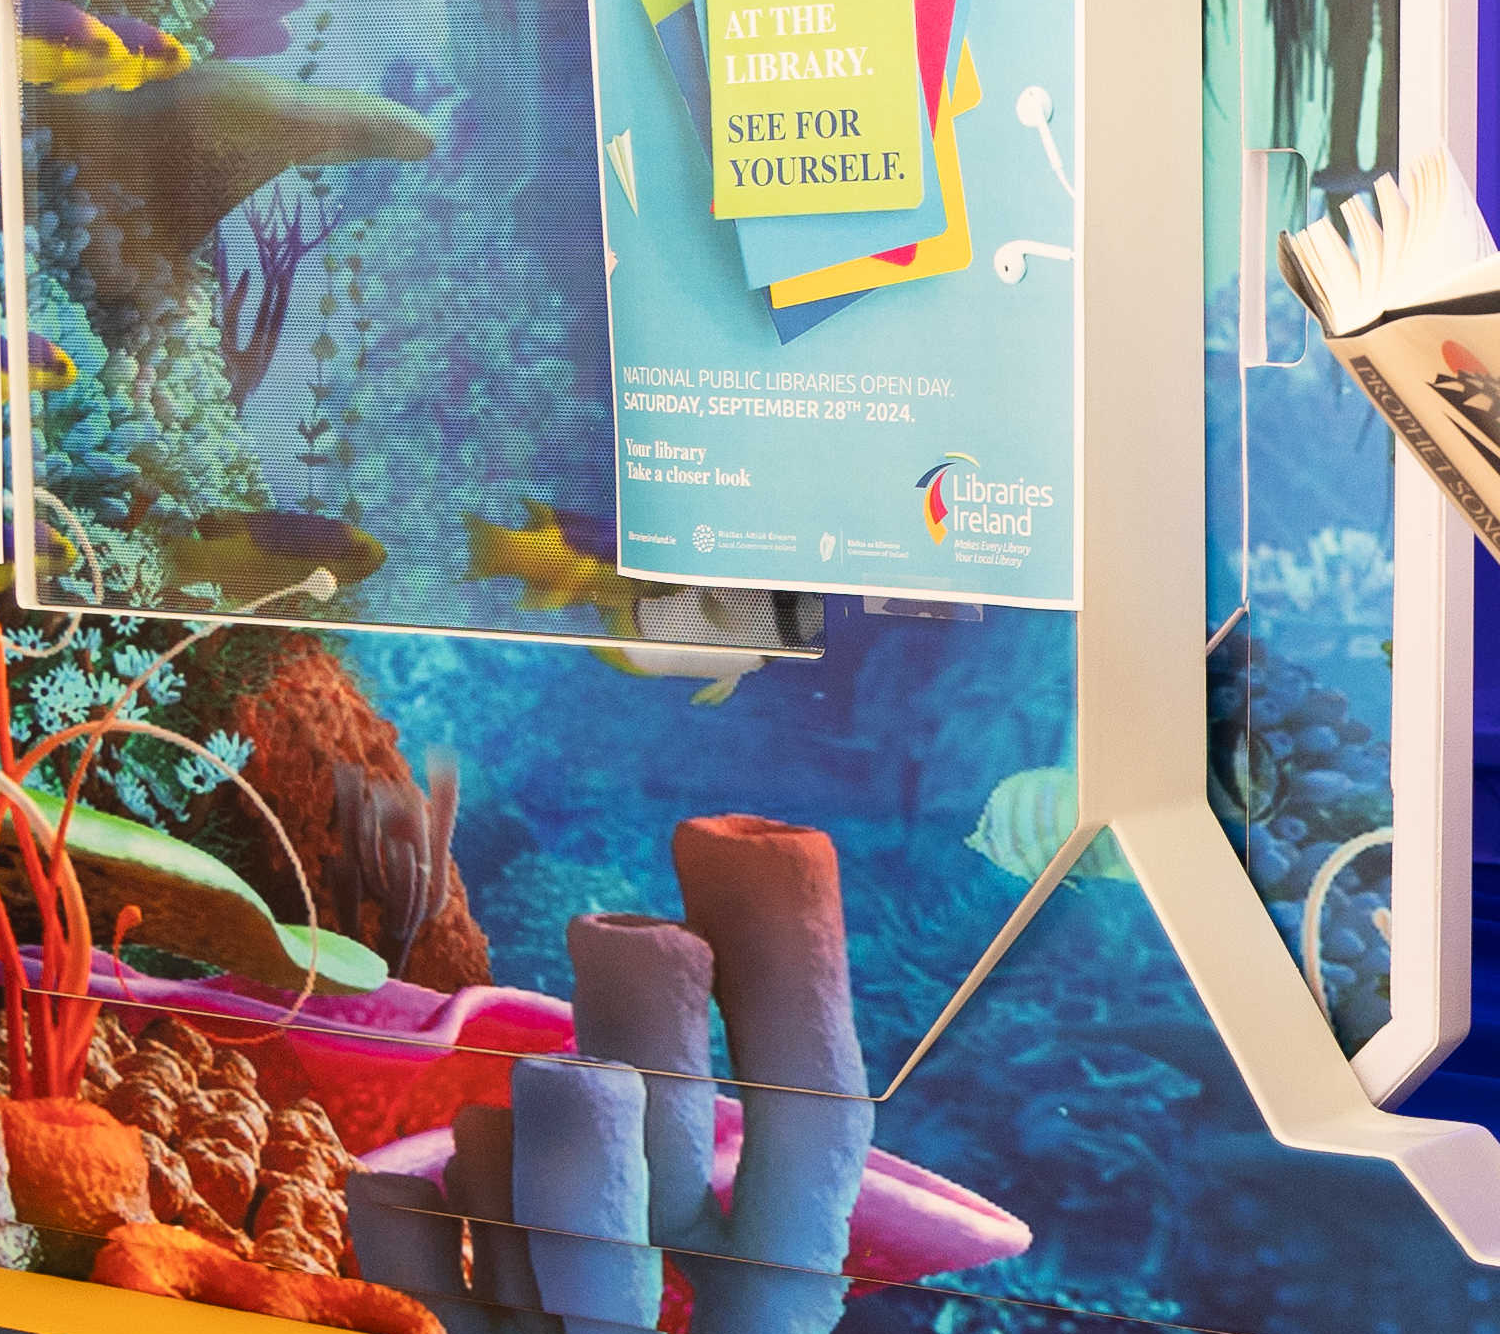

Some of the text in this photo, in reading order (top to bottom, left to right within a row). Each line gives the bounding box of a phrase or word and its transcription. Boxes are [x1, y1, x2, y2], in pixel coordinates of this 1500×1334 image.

[724, 3, 837, 40] AT THE
[725, 46, 874, 85] LIBRARY.
[728, 109, 861, 144] SEE FOR
[730, 152, 904, 188] YOURSELF.
[623, 366, 956, 398] NATIONAL PUBLIC LIBRARIES OPEN DAY.
[623, 392, 916, 423] SATURDAY, SEPTEMBER 28TH 2024.
[1357, 366, 1453, 473] PROPHET
[625, 438, 707, 465] Your library
[626, 462, 751, 488] Take a closer look
[953, 473, 1053, 508] Libraries
[953, 504, 1032, 537] Ireland
